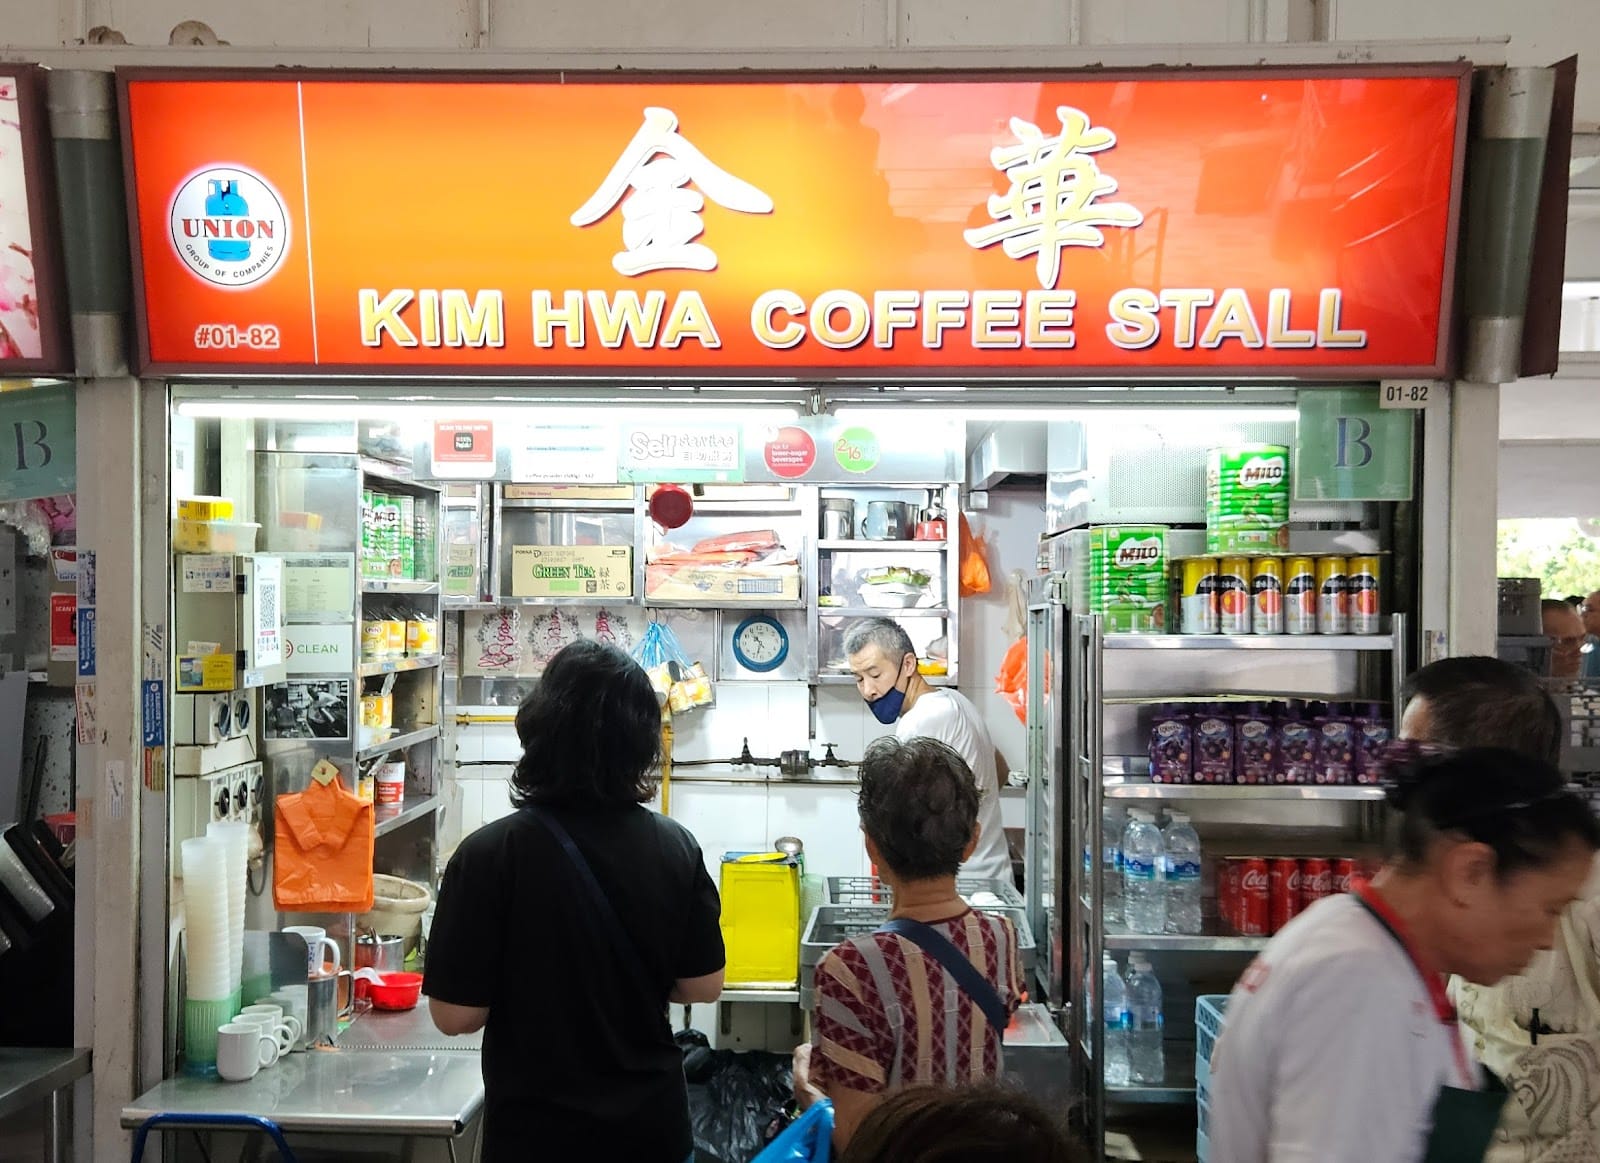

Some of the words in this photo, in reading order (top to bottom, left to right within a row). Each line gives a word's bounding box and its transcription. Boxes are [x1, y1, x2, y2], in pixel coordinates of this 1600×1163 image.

[570, 106, 774, 277] 金
[964, 106, 1143, 289] 華
[181, 218, 275, 239] UNION
[185, 244, 210, 271] GROUP
[214, 268, 228, 278] OF
[232, 245, 274, 279] COMPANIES
[358, 289, 504, 347] KIM
[531, 289, 723, 348] HWA
[750, 289, 1077, 349] COFFEE
[1105, 288, 1367, 349] STALL
[195, 325, 279, 348] #01-82
[1386, 386, 1429, 402] 01-82
[13, 420, 52, 471] B
[1335, 416, 1373, 468] B
[1244, 466, 1282, 482] MILO
[1119, 547, 1158, 562] MILO
[532, 563, 571, 579] GREEN
[572, 563, 596, 579] TEA
[296, 644, 339, 654] CLEAN
